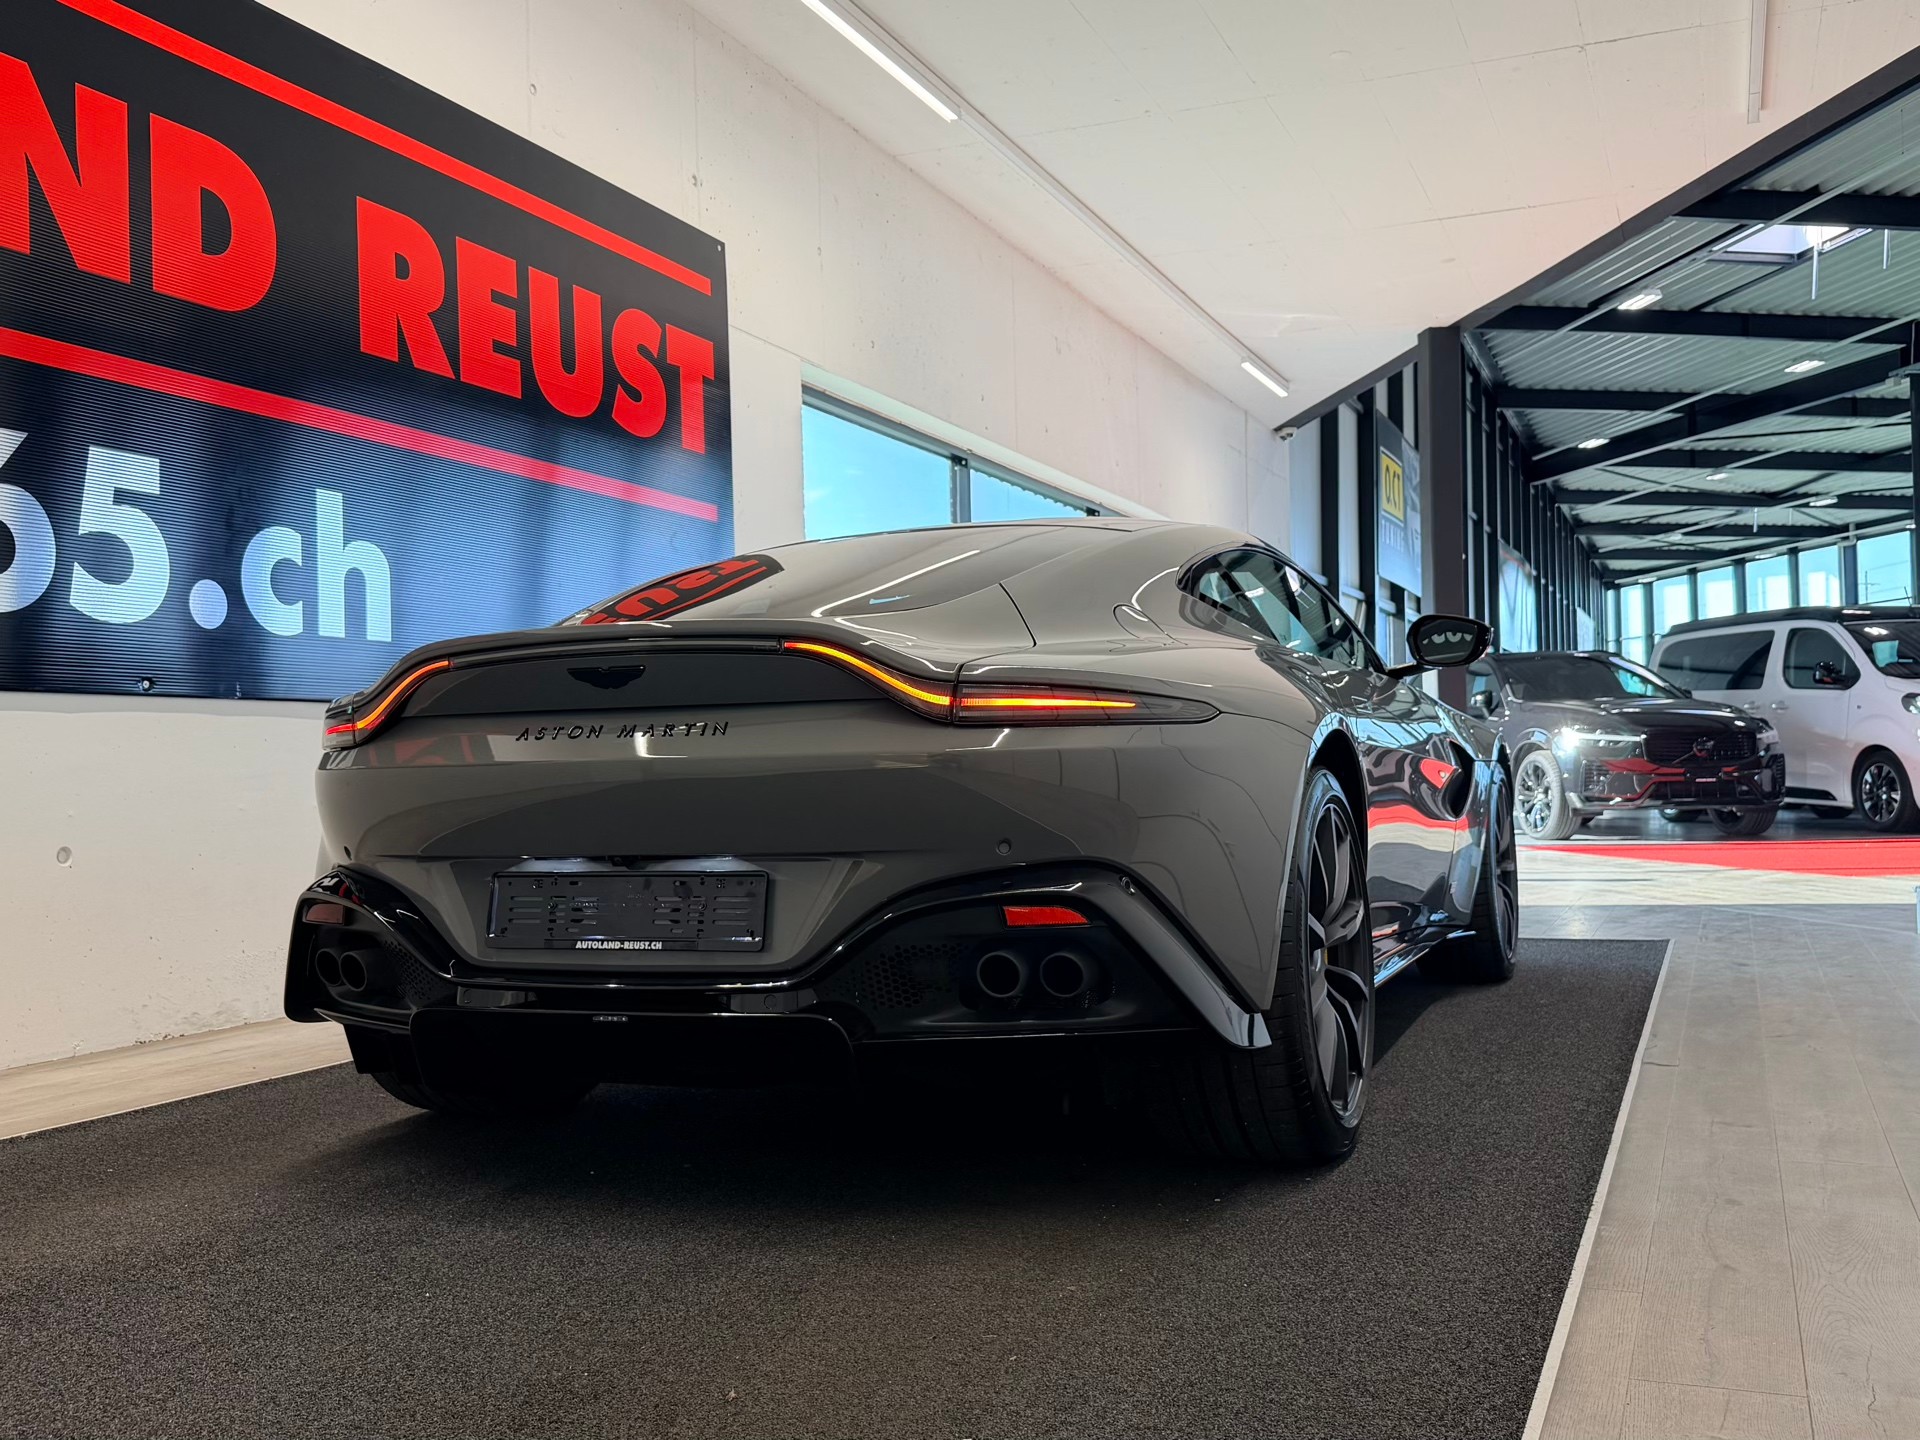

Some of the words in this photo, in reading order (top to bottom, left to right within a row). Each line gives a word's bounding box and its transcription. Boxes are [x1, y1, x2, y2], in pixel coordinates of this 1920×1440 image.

[356, 196, 715, 454] REUST
[515, 725, 604, 742] ASTON
[616, 721, 729, 739] MARTIN
[575, 940, 663, 950] AUTOLAND-REUST.CH
